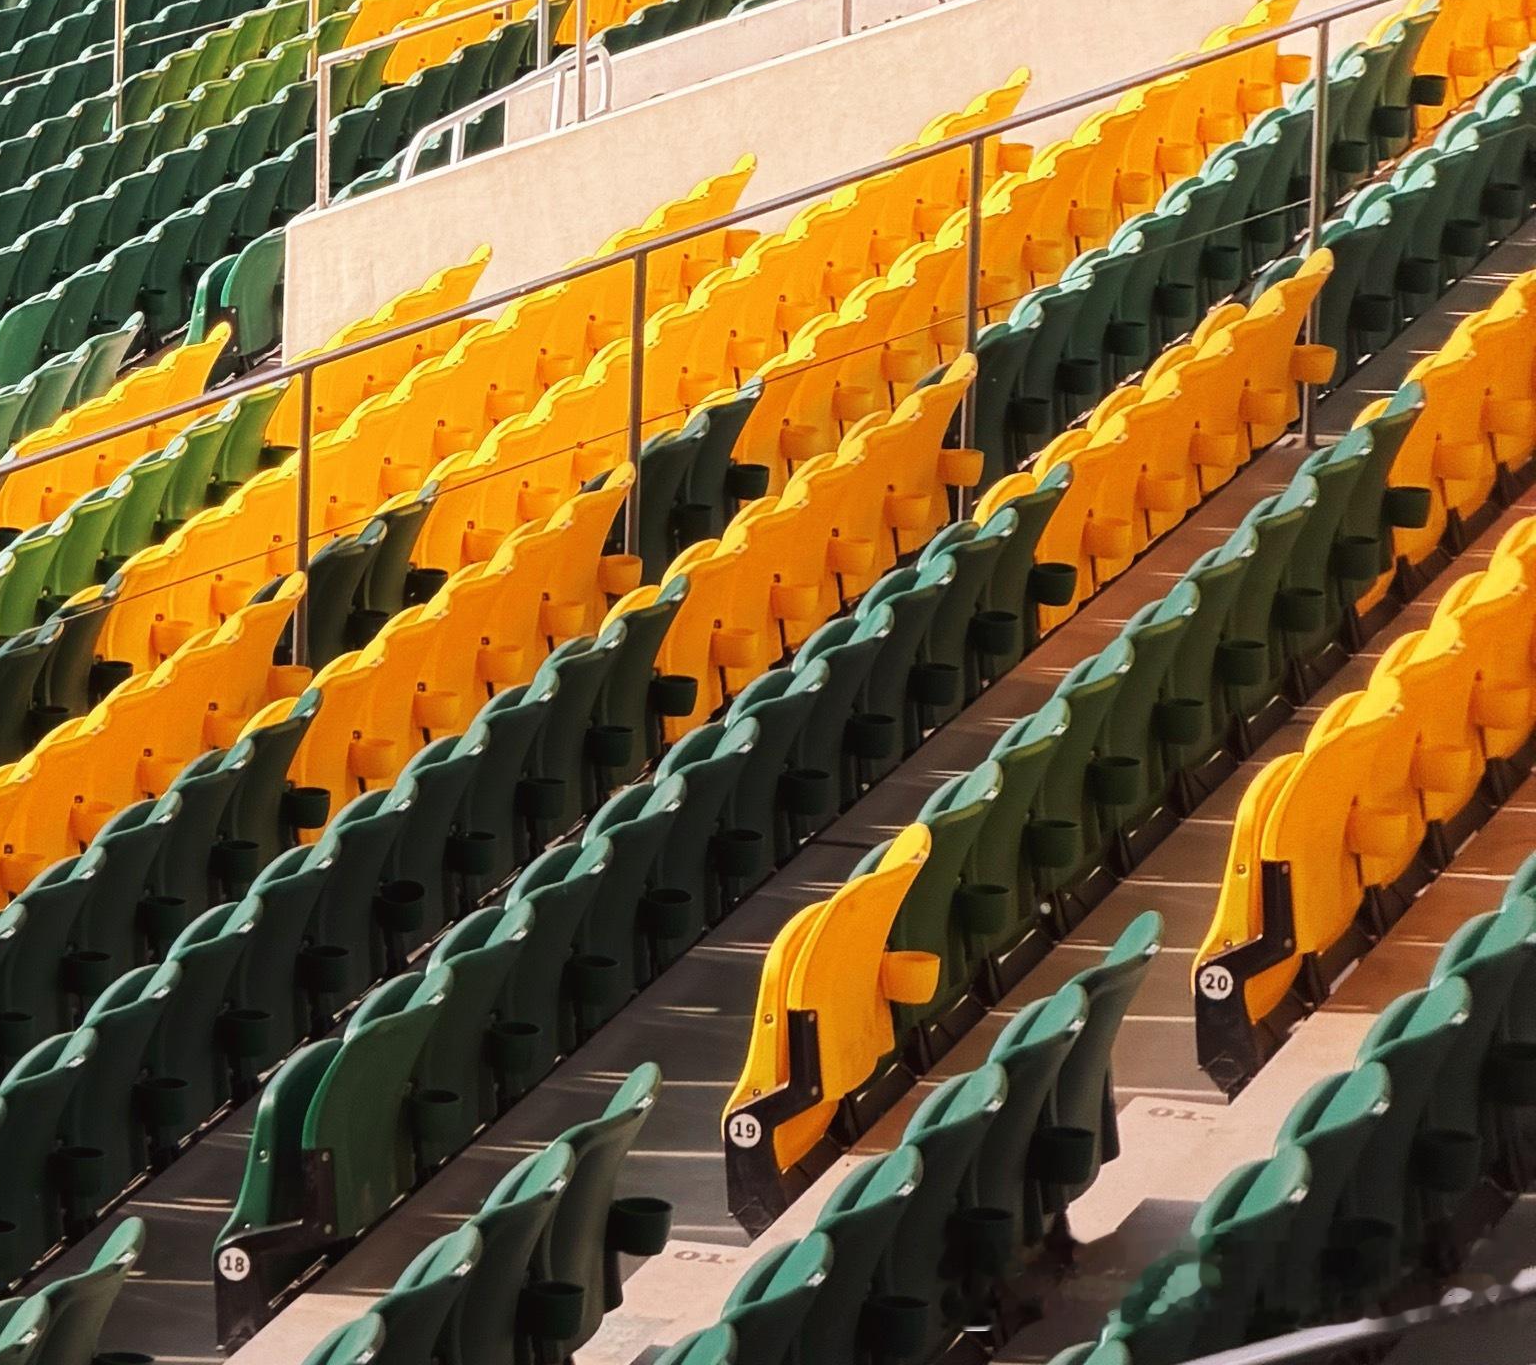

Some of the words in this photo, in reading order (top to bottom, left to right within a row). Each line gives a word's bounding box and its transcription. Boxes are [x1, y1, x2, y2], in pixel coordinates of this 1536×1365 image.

[1205, 973, 1228, 991] 20
[734, 1121, 756, 1139] 19
[223, 1255, 245, 1273] 18
